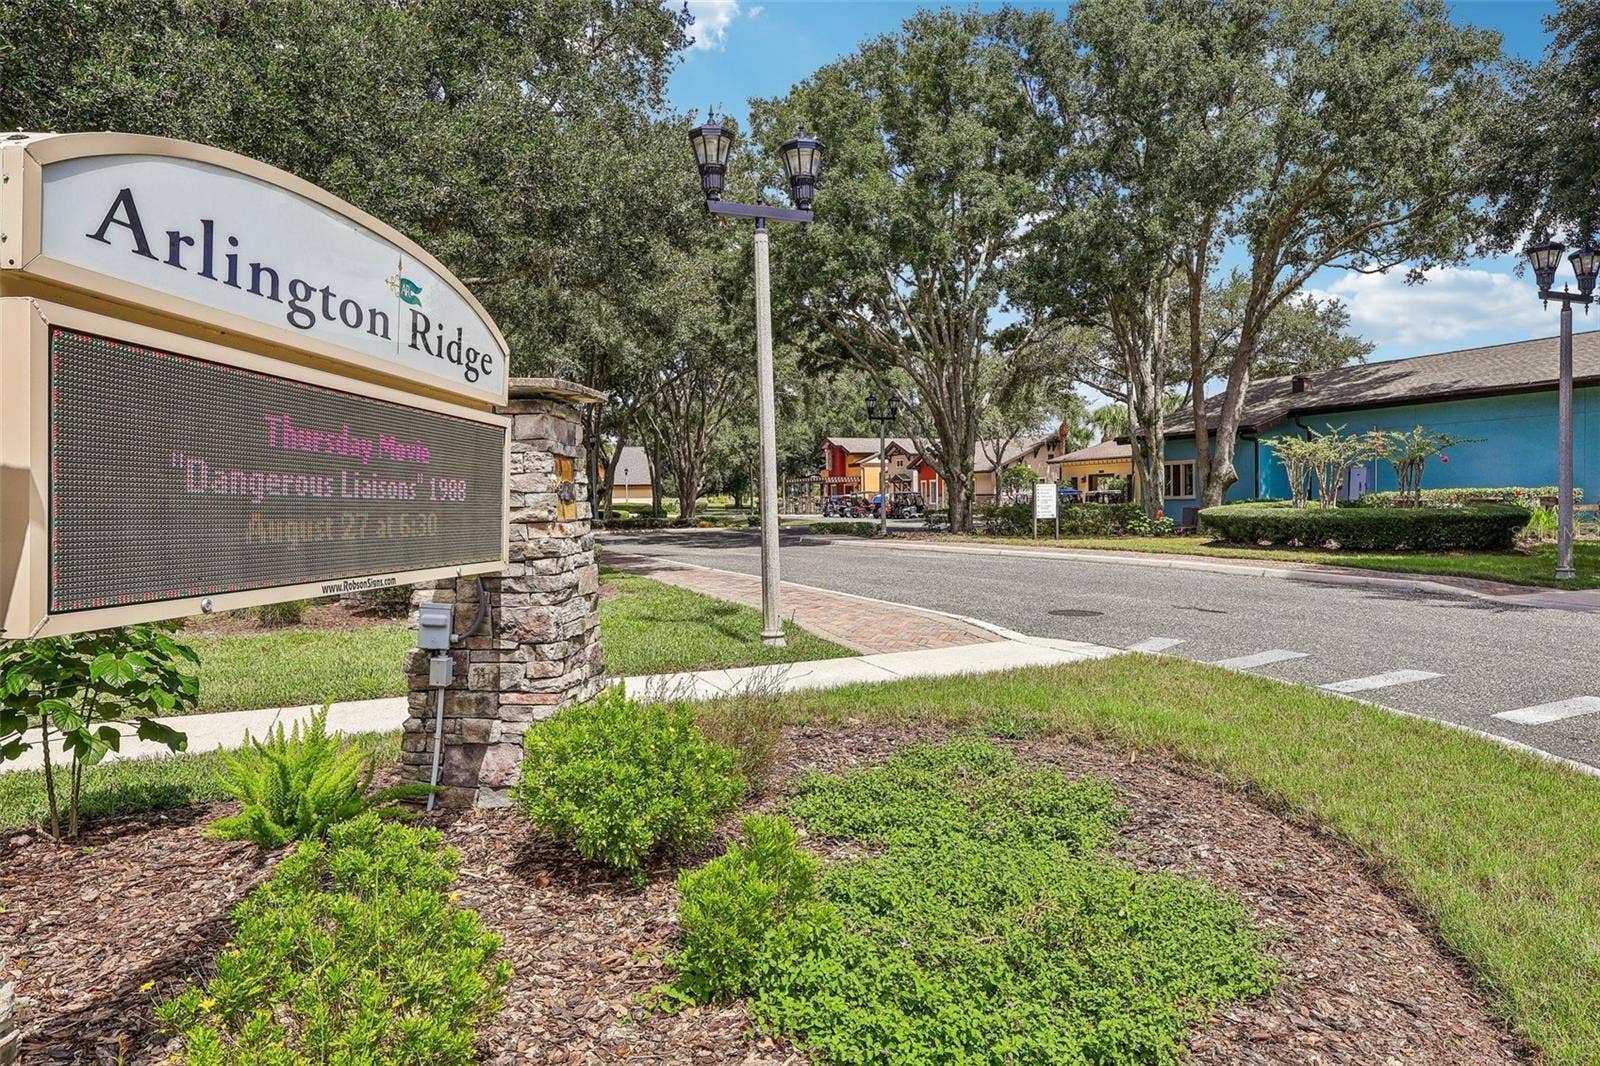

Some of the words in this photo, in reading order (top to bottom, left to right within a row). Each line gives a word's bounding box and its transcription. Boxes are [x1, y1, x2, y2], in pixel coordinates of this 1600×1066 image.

[85, 187, 392, 340] Arlington
[408, 308, 493, 383] Ridge
[265, 413, 373, 465] Thursday
[379, 432, 431, 464] Movie
[171, 451, 334, 503] "Dangerous
[340, 471, 424, 500] Liaisons"
[430, 478, 467, 501] 1988
[245, 511, 333, 550] August
[341, 512, 368, 540] 27
[376, 516, 393, 539] at
[399, 512, 438, 538] 6:30
[321, 577, 397, 594] www.RobsonSigns.com
